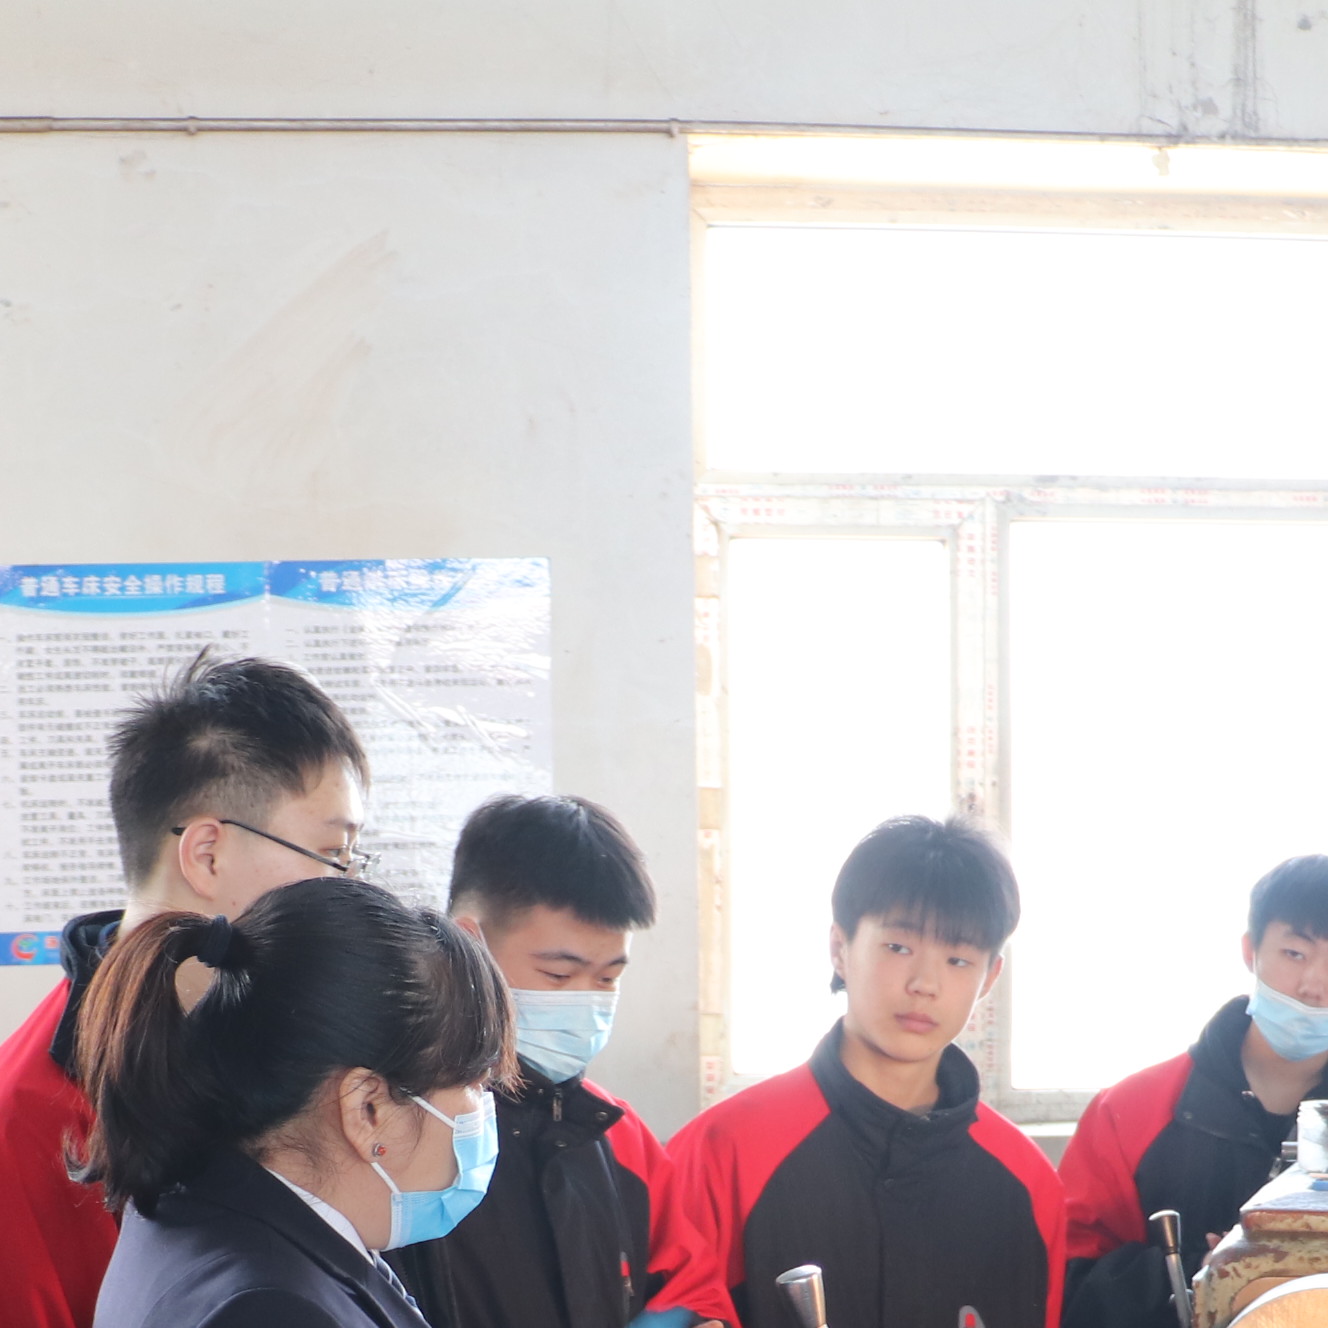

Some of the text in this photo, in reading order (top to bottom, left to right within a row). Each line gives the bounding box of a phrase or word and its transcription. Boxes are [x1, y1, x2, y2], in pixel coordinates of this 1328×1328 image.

[20, 573, 227, 598] 普通车床安全操作规程
